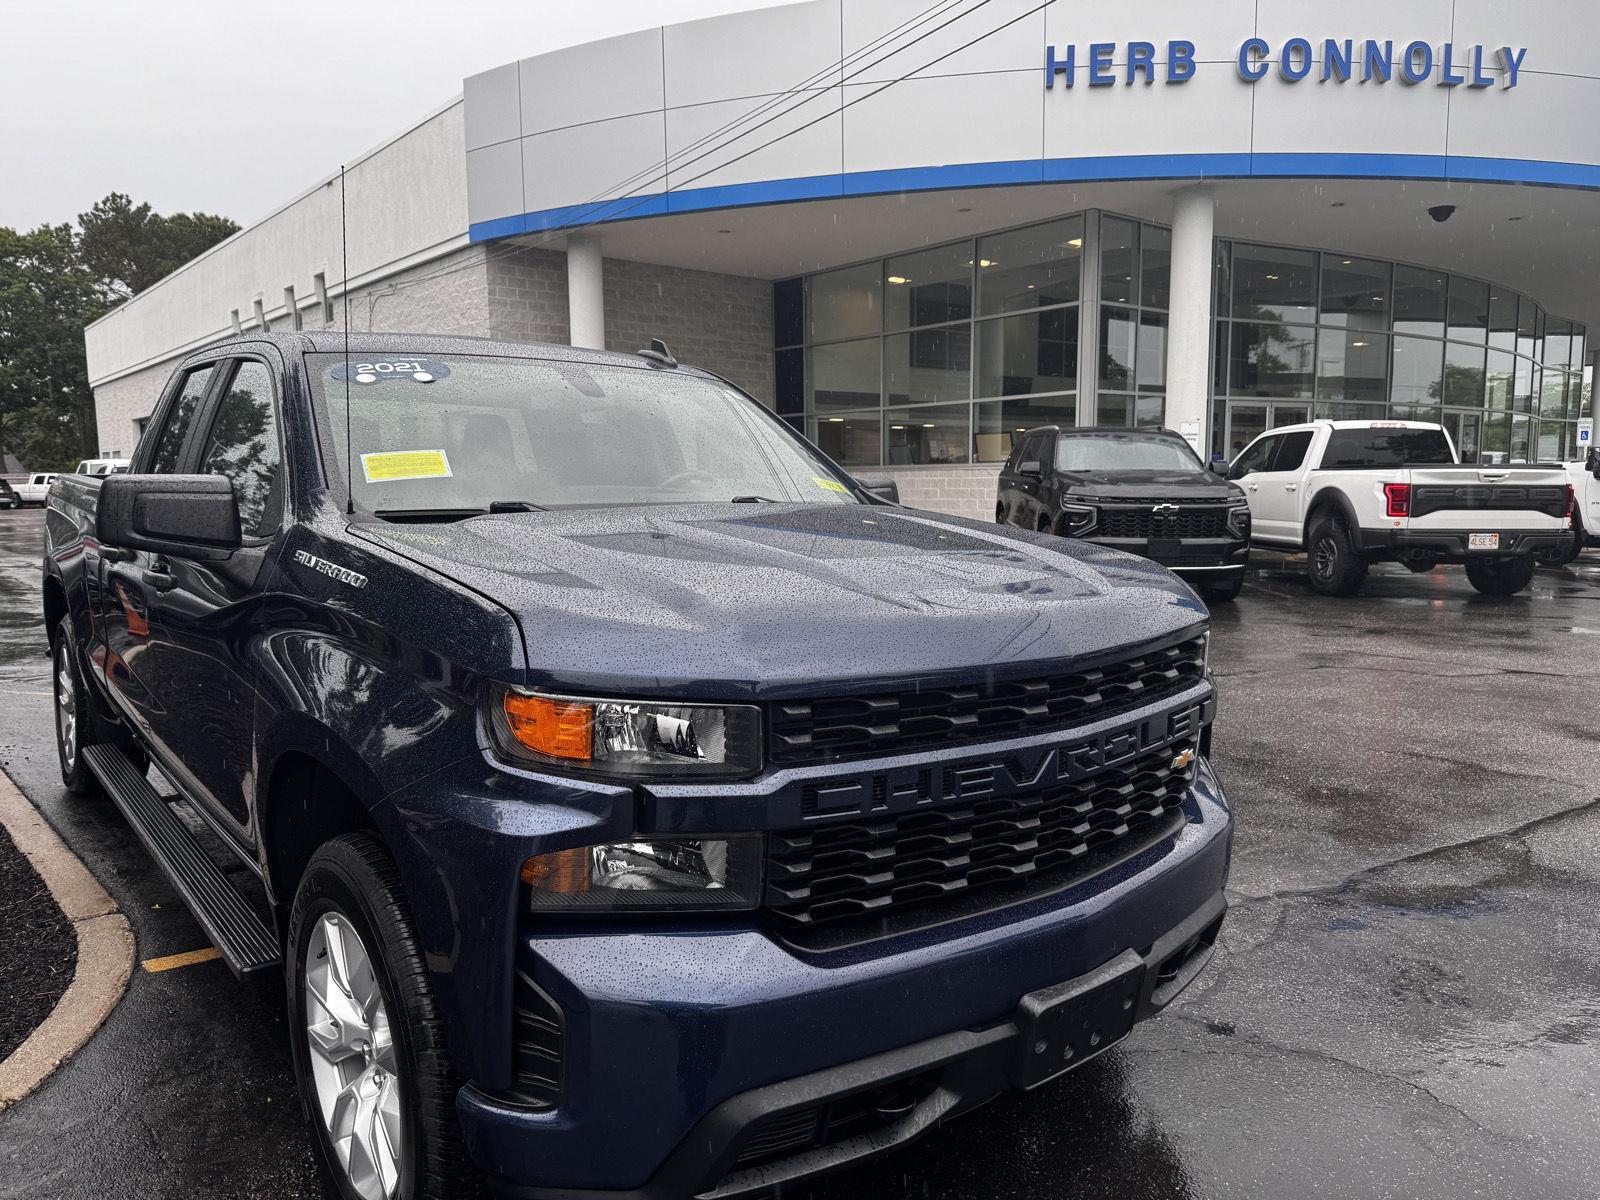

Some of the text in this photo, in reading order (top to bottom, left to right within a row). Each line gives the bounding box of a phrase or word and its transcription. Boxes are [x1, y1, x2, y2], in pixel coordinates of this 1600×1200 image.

[1046, 37, 1527, 90] HERB CONNOLLY
[356, 363, 426, 373] 2021
[1417, 488, 1562, 500] FORD
[293, 550, 369, 588] SILVERADO
[803, 696, 1212, 820] CHEVROLET
